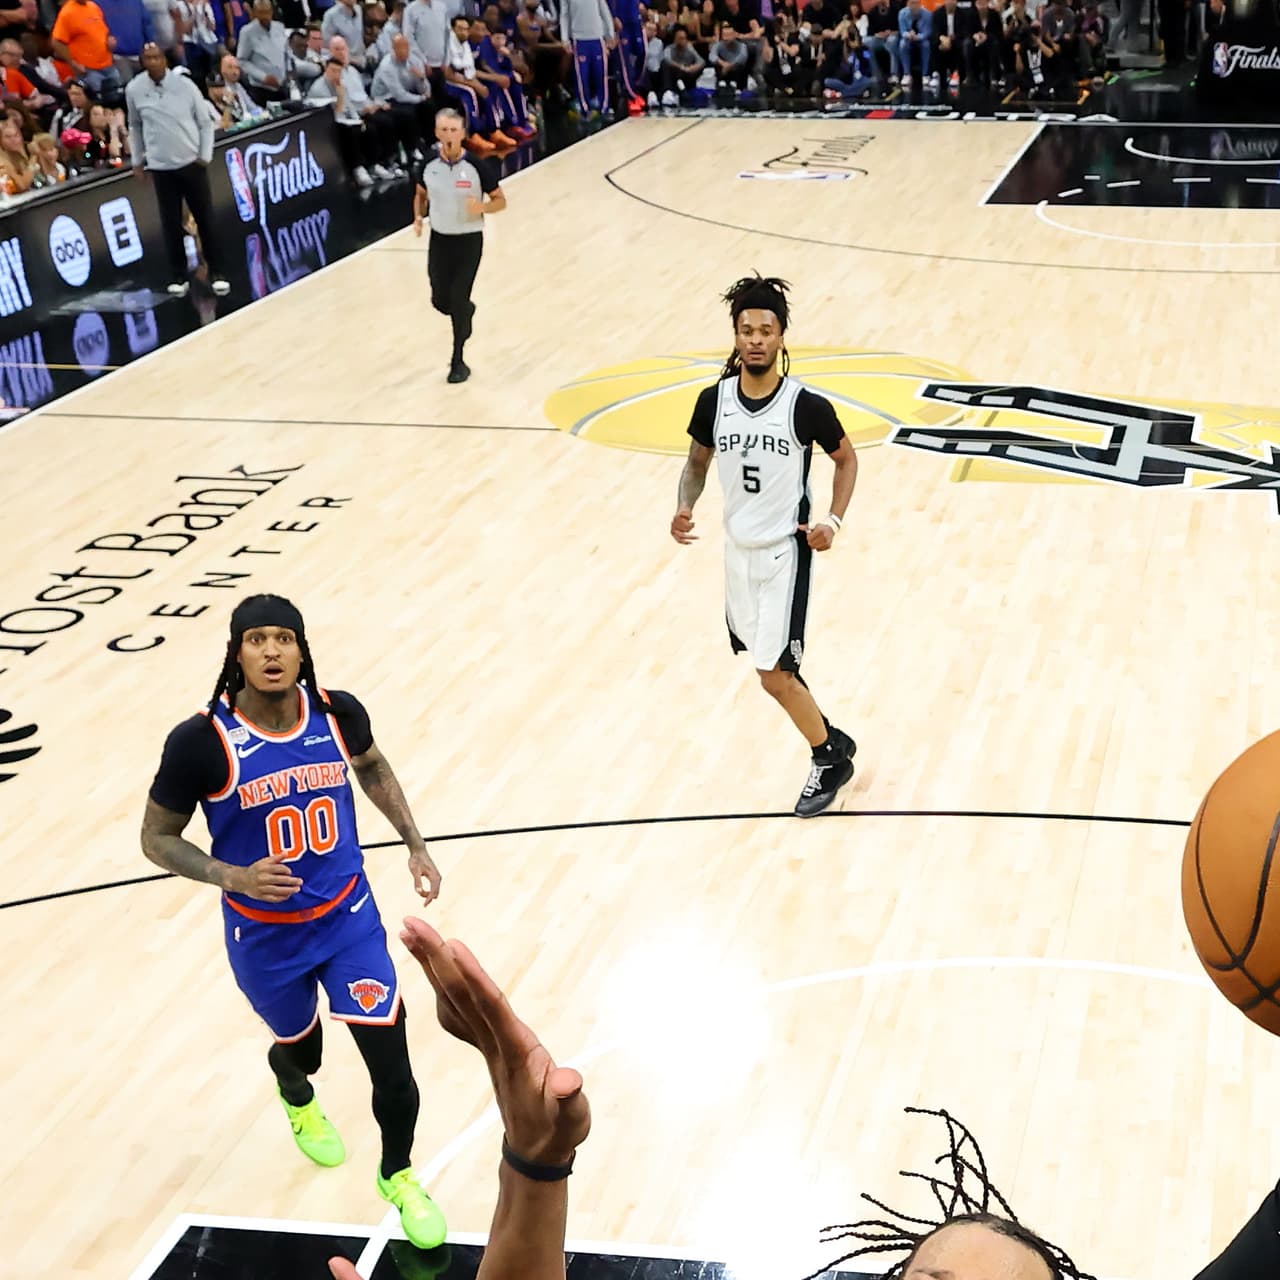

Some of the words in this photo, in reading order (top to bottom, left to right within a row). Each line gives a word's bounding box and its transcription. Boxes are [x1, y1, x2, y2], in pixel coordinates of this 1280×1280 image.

[244, 130, 325, 225] Finals
[718, 433, 790, 457] SPURS
[75, 463, 305, 558] Bank
[742, 465, 761, 493] 5
[107, 495, 353, 653] CENTER
[237, 769, 291, 809] NEW
[289, 761, 346, 793] YORK
[265, 796, 339, 863] 00
